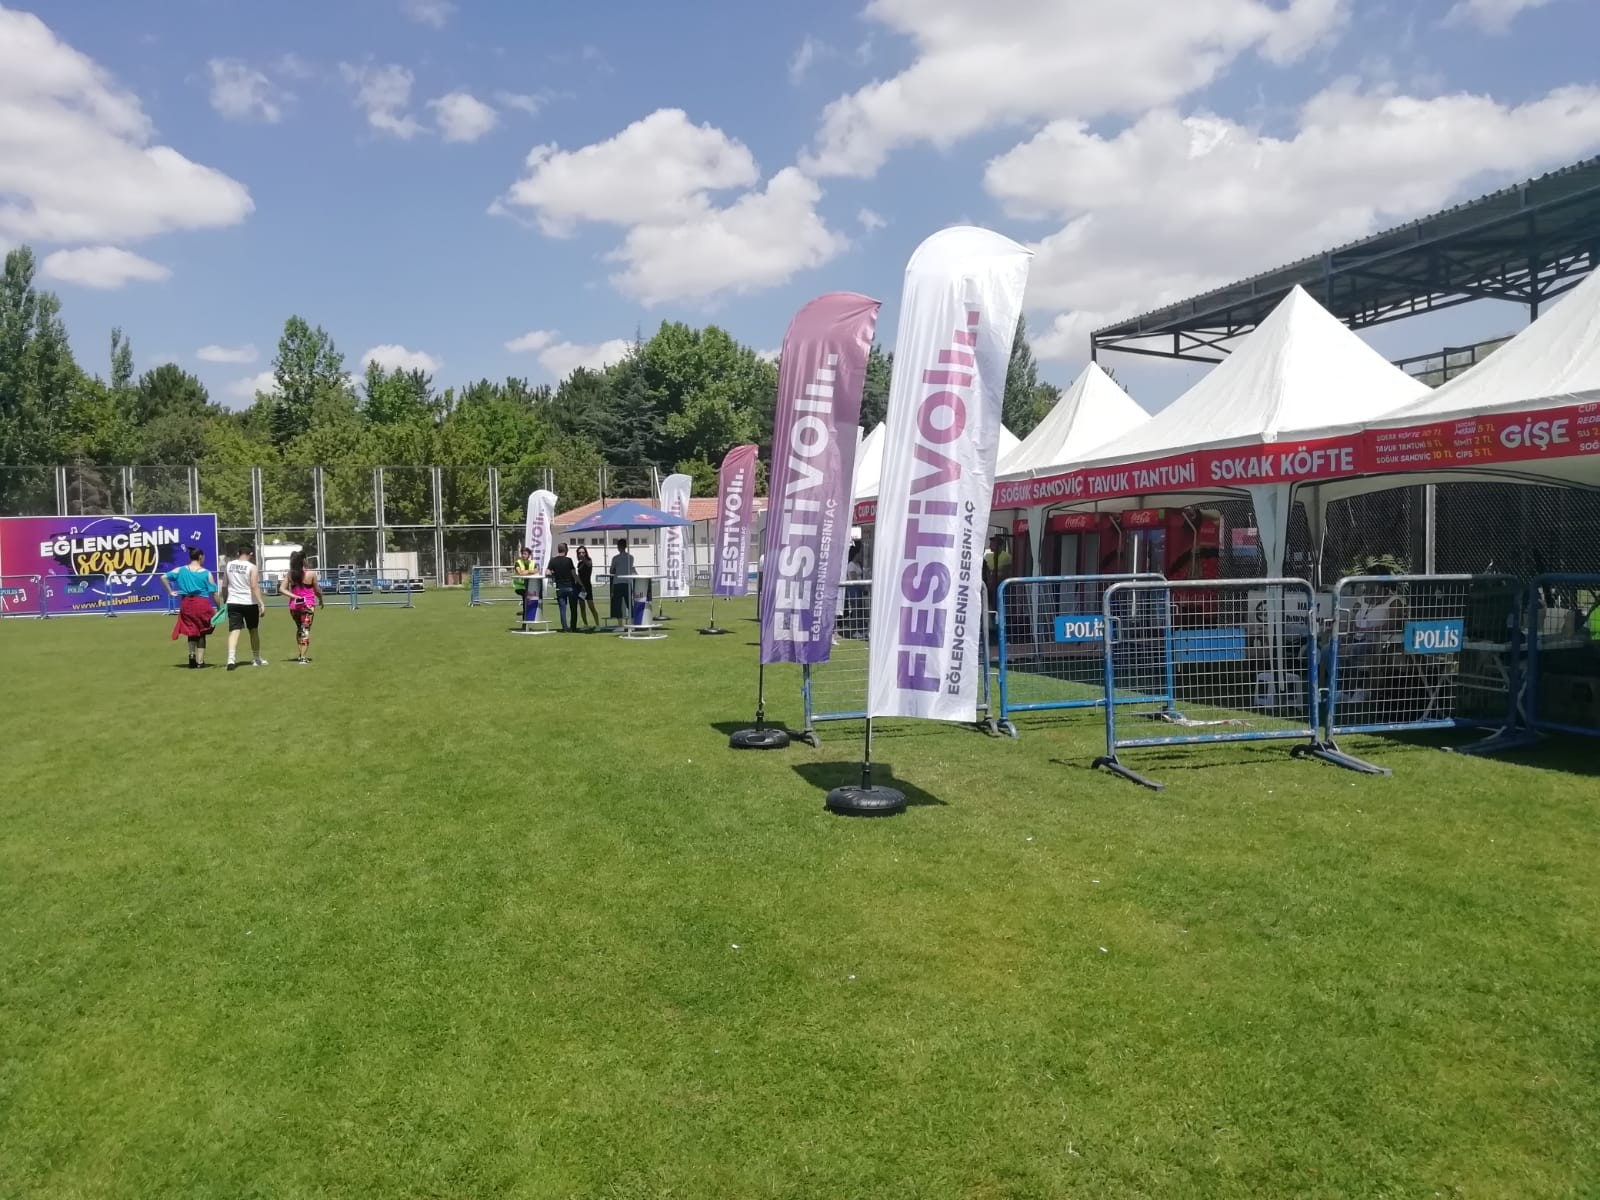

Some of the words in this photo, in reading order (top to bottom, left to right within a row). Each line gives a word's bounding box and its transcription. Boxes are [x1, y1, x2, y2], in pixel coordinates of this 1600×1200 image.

[1482, 435, 1492, 444] TL
[1500, 417, 1570, 451] GİŞE
[1376, 444, 1397, 453] TAVUK
[1433, 451, 1442, 459] 10
[1444, 450, 1453, 458] TL
[1481, 447, 1492, 456] TL
[1211, 455, 1274, 481] SOKAK
[1280, 446, 1354, 476] KÖFTE
[1001, 483, 1032, 503] SOĞUK
[1033, 474, 1084, 498] SANDVİÇ
[1088, 472, 1129, 493] TAVUK
[1132, 457, 1195, 488] TANTUNİ
[826, 499, 838, 518] AÇ
[965, 500, 976, 526] AÇ
[105, 568, 137, 586] AÇ
[1413, 625, 1459, 649] POLİS
